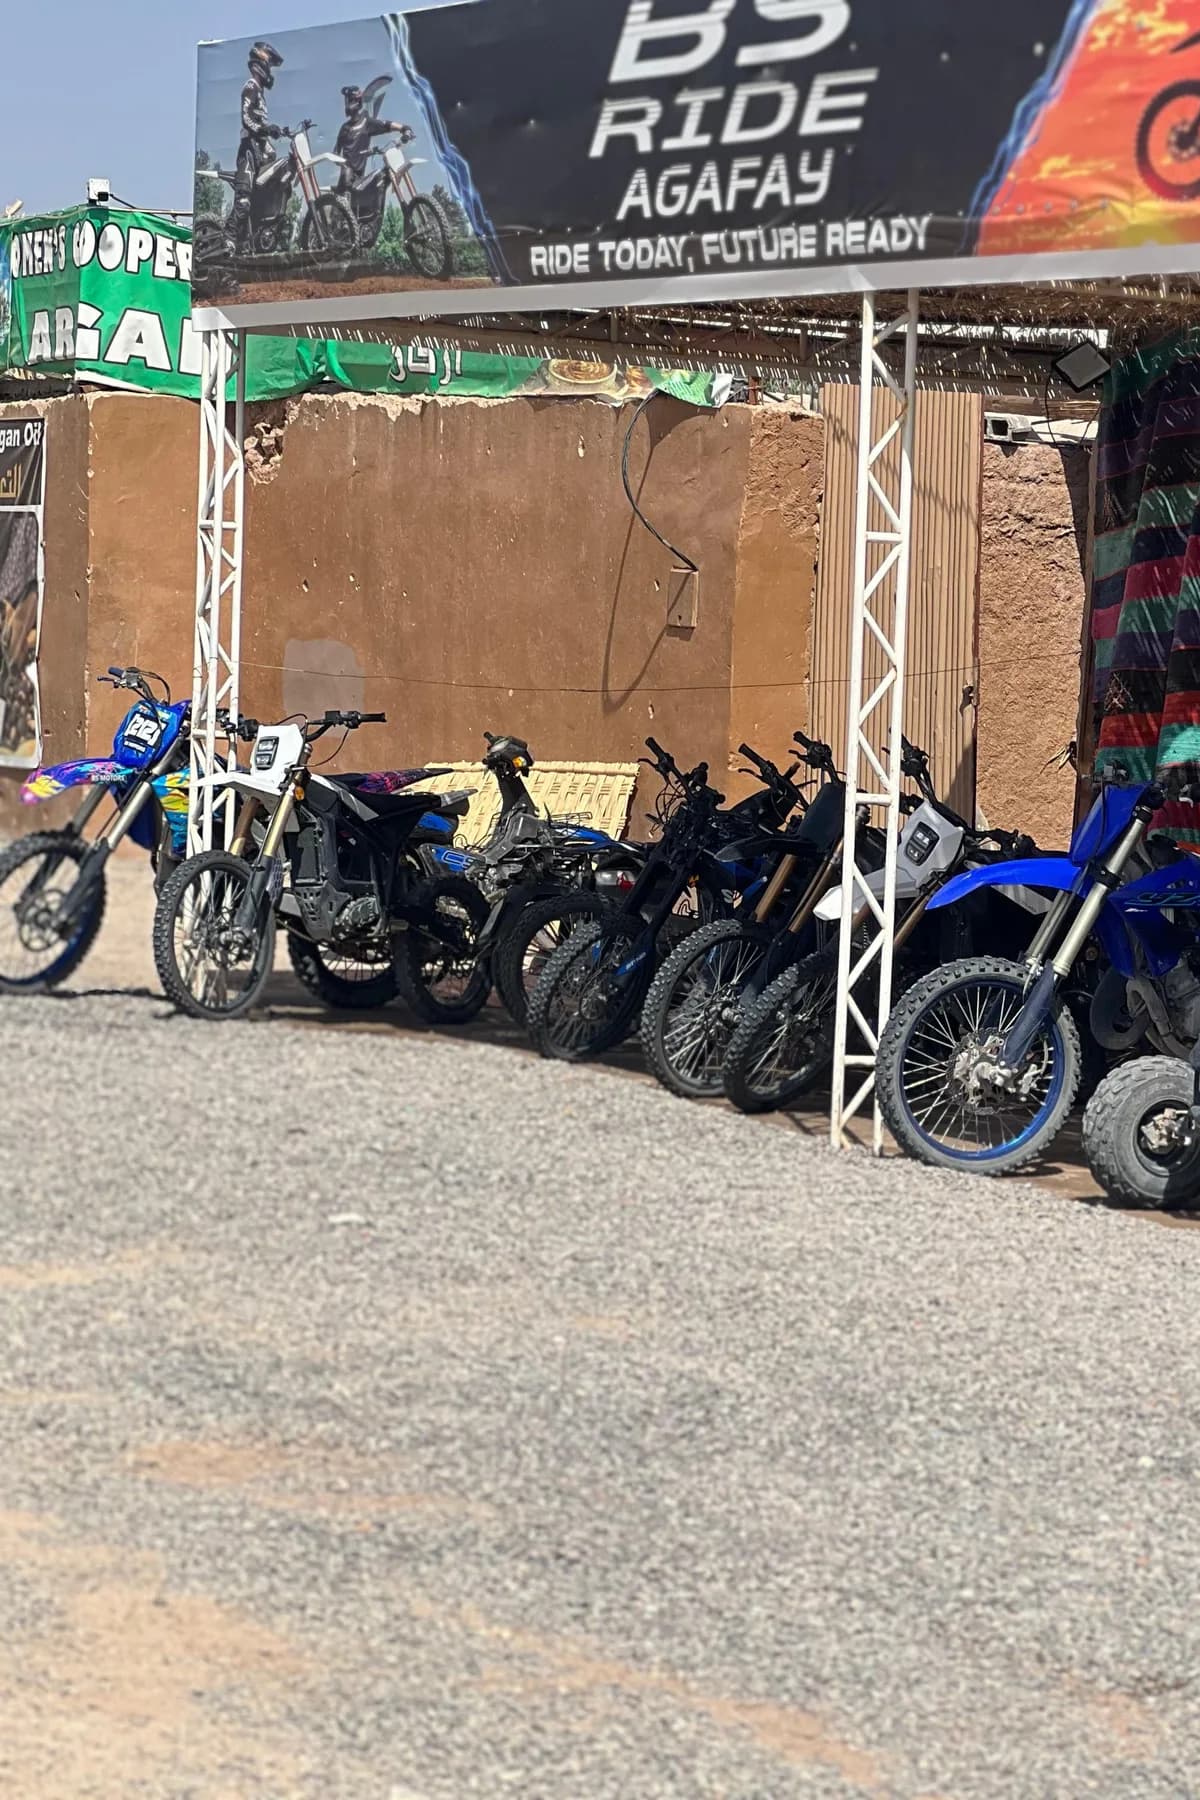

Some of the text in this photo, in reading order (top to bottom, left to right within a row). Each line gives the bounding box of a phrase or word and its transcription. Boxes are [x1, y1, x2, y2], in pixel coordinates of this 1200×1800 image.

[608, 0, 851, 84] BS
[589, 67, 879, 159] RIDE
[616, 147, 835, 220] AGAFAY
[530, 214, 933, 277] RIDE TODAY, FUTURE READY
